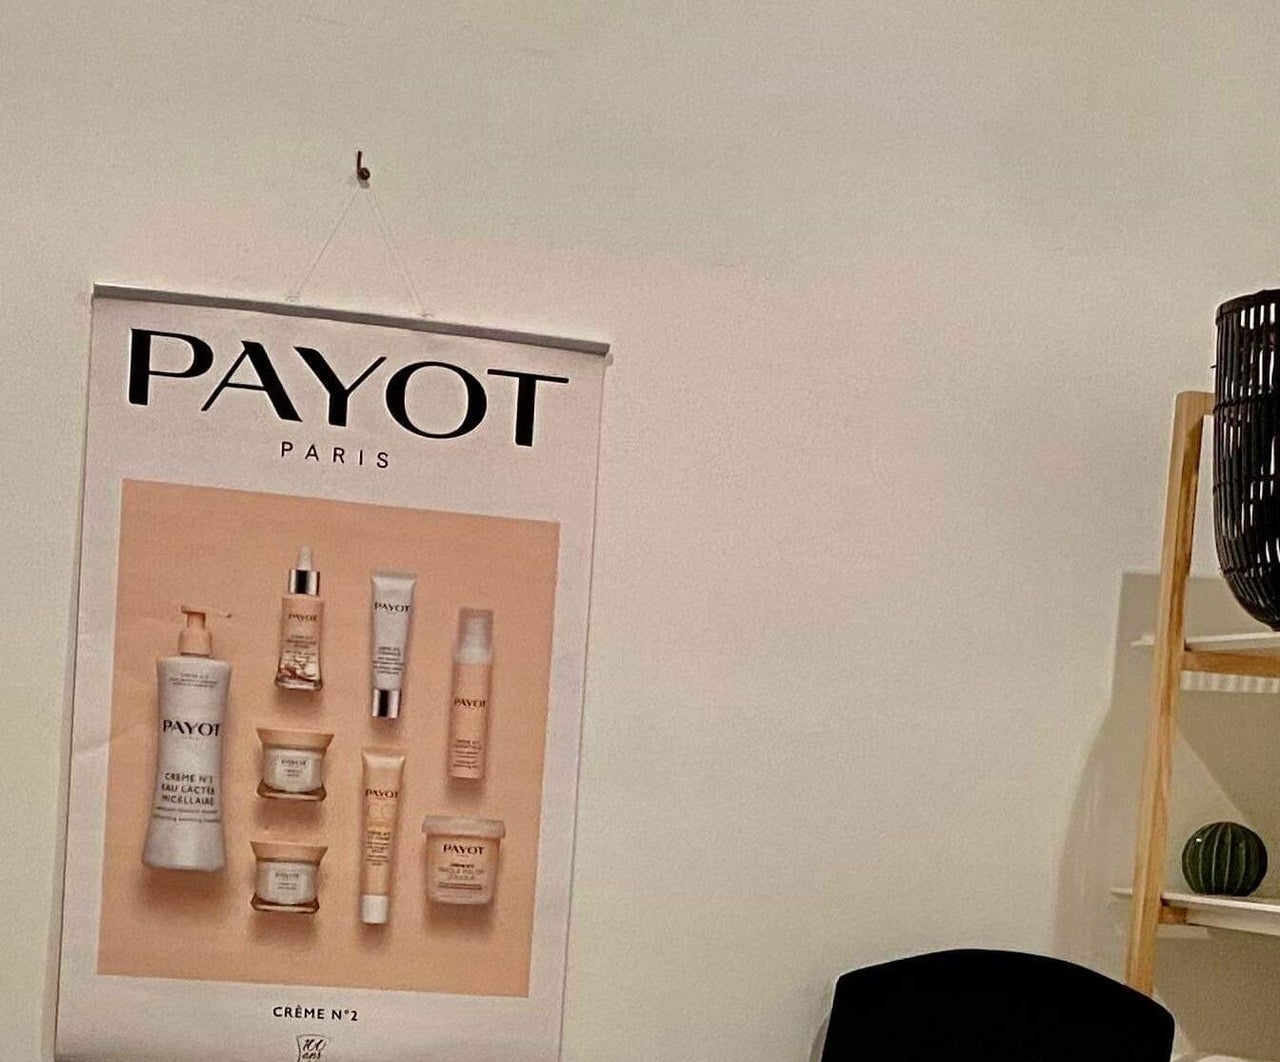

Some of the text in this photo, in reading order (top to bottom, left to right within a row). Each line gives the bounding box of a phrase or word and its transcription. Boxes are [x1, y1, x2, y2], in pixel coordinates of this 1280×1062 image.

[128, 327, 570, 447] PAYOT
[280, 440, 390, 468] PARIS
[374, 601, 411, 612] PAYOT
[163, 719, 221, 737] PAYOT
[443, 844, 486, 855] PAYOT
[272, 1004, 358, 1021] CRÈME N°2
